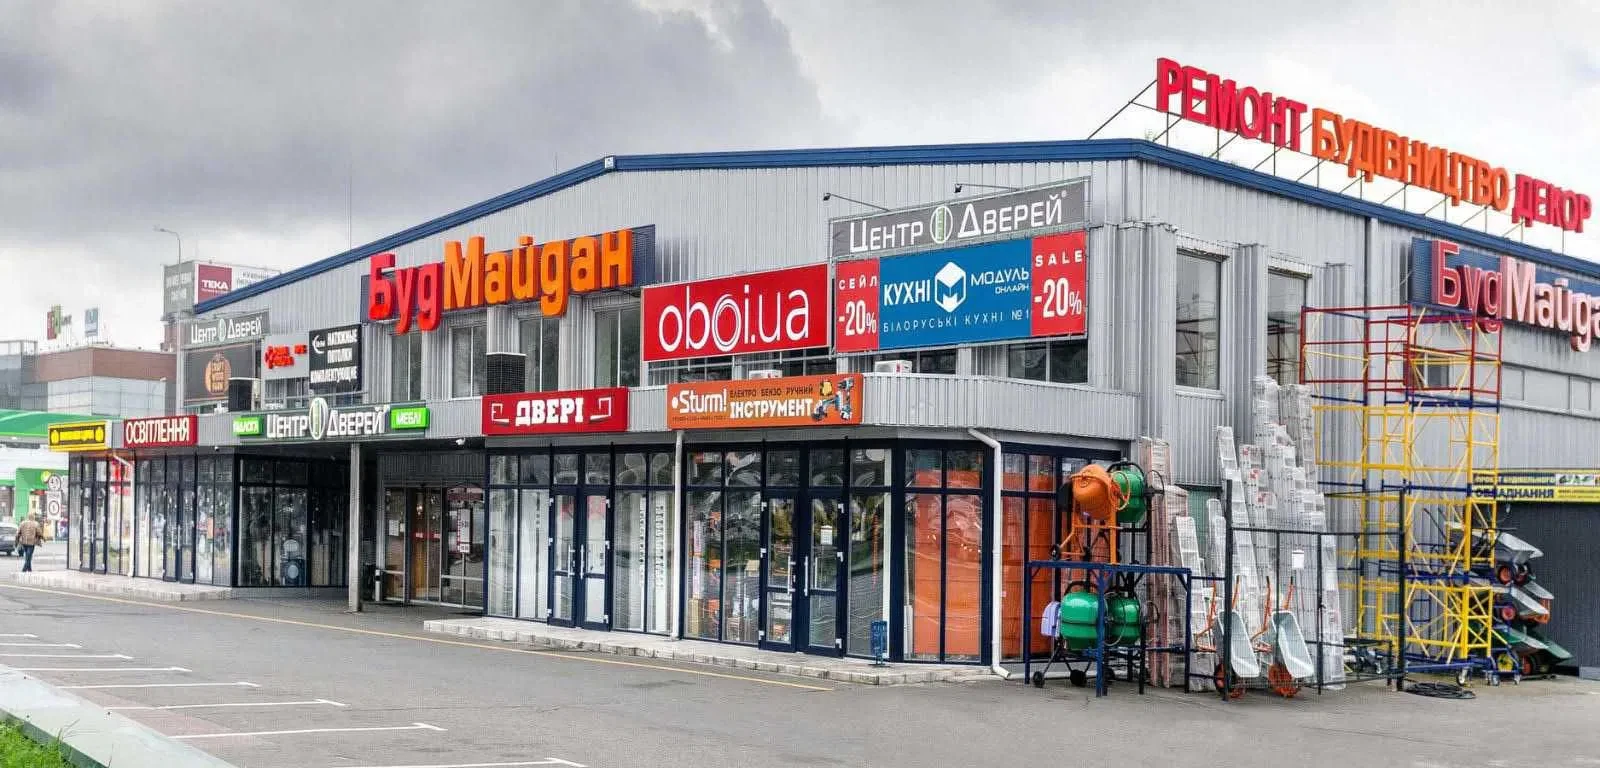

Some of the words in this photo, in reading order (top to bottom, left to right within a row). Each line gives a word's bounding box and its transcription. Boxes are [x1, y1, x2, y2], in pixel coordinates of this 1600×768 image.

[1157, 57, 1308, 151] РЕМОНТ
[1312, 107, 1509, 212] БУДІВНИЦТВО
[1511, 173, 1592, 233] ДЕКОР
[1035, 249, 1084, 268] SALE
[201, 280, 229, 290] TEKA
[838, 274, 878, 291] СЕЙЛ
[970, 267, 1030, 288] МОДУЛЬ
[994, 282, 1030, 295] ОНЛАЙН
[883, 279, 931, 307] КУХНІ
[1034, 277, 1083, 319] -20%
[658, 284, 810, 353] oboi.ua
[838, 299, 877, 337] -20%
[883, 317, 958, 333] БІЛОРУСЬКІ
[964, 311, 1004, 326] КУХНІ
[679, 388, 727, 414] Sturm!
[729, 389, 757, 398] ЕЛЕКТРО
[761, 387, 782, 397] БЕНЗО
[785, 384, 814, 396] РУЧНИЙ
[515, 397, 584, 427] ДВЕРІ
[729, 399, 813, 419] ІНСТРУМЕНТ
[125, 417, 190, 444] ОСВІТЛЕННЯ
